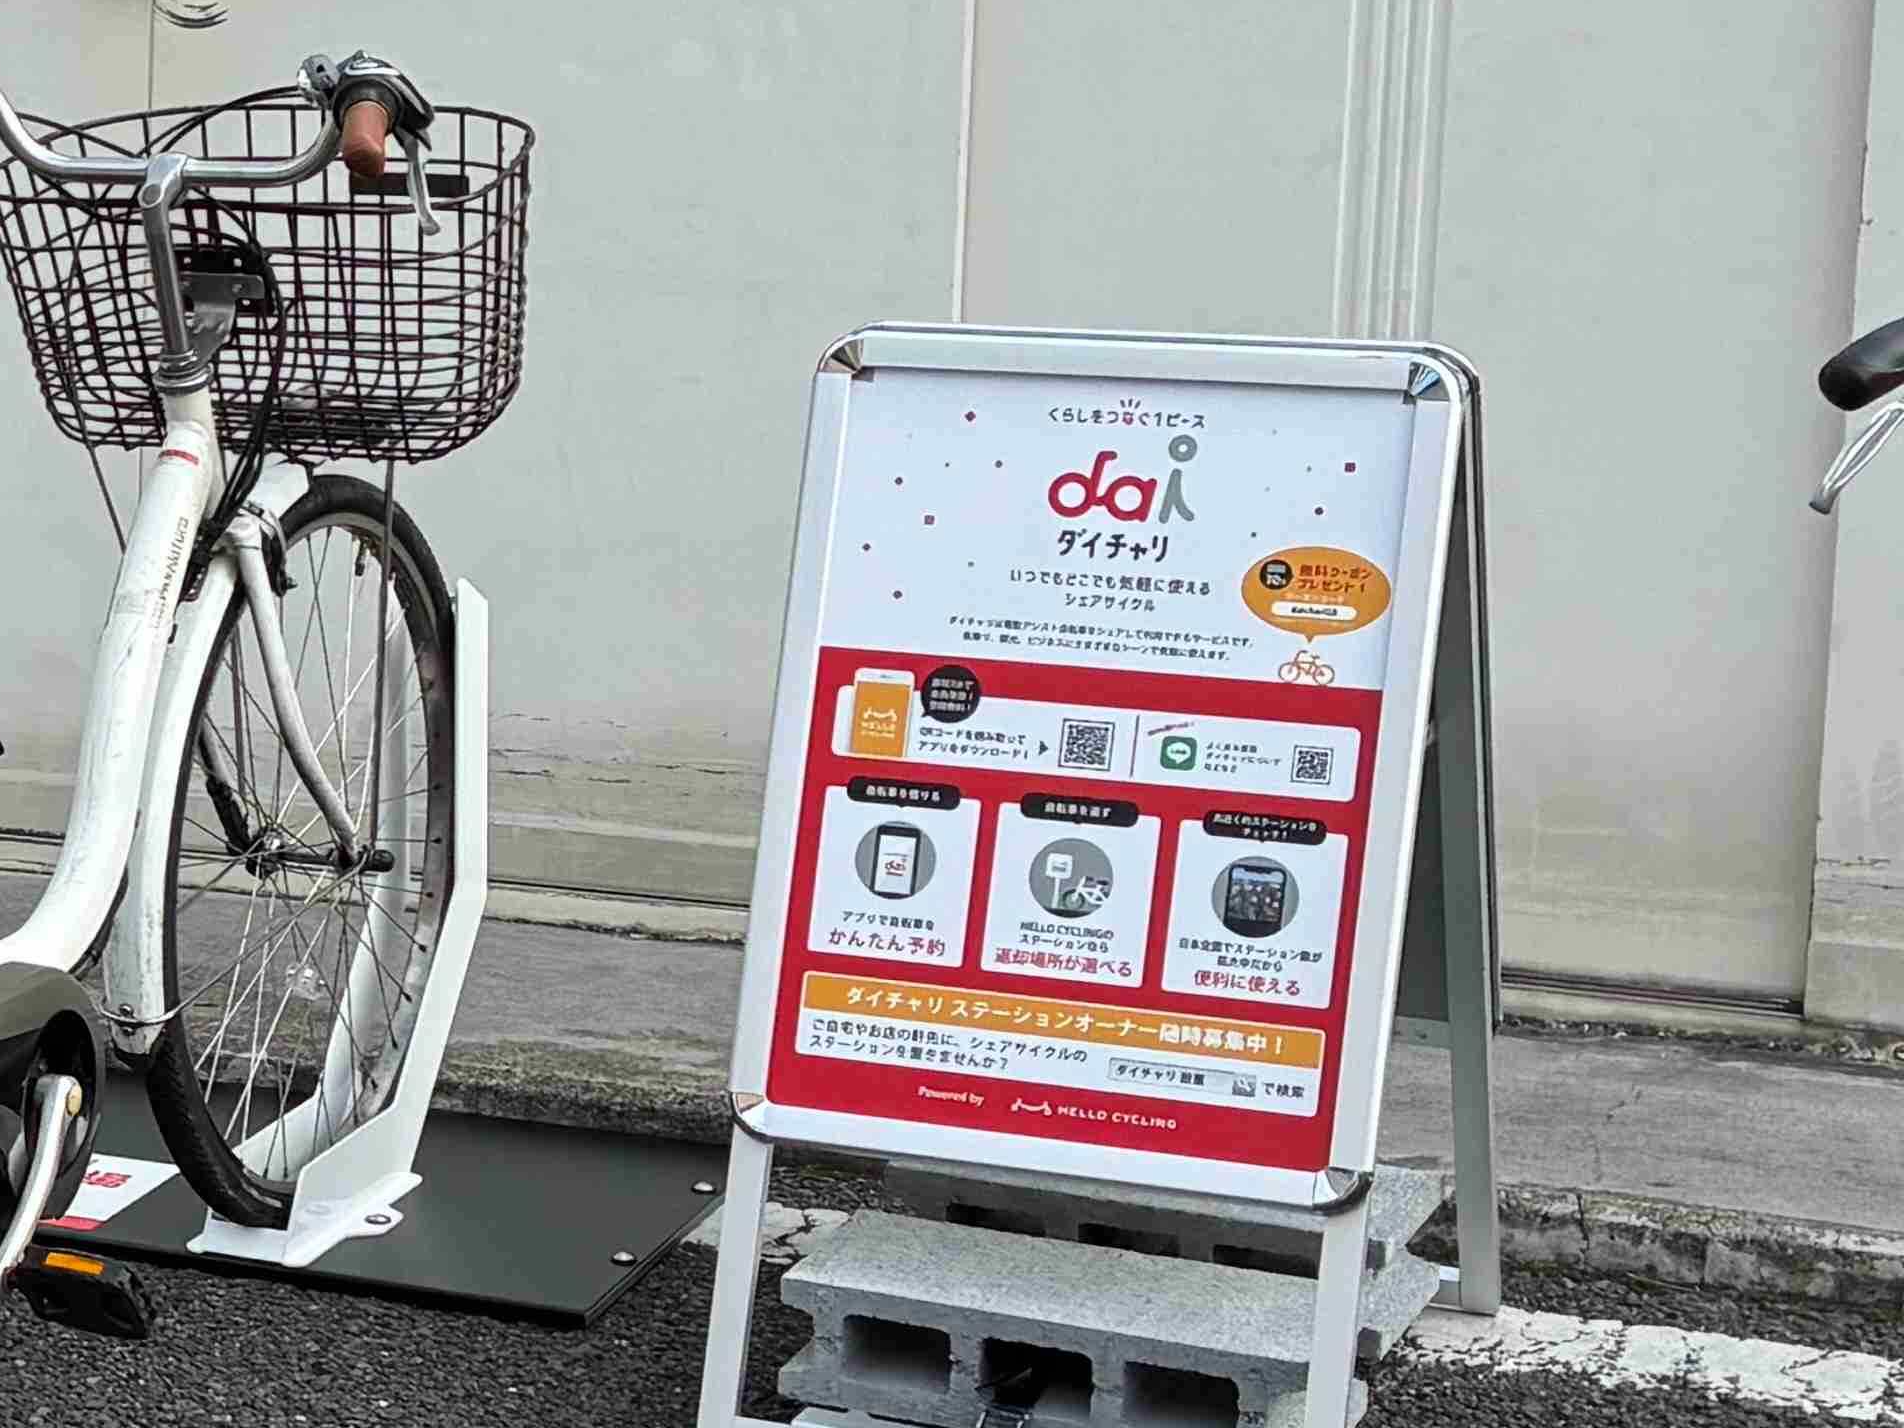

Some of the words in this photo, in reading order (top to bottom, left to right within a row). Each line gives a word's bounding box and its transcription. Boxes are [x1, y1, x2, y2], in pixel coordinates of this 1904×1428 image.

[1048, 434, 1198, 524] dai
[1057, 529, 1169, 563] ダイチャリ
[1009, 567, 1211, 597] いつでもどこでも気軽に使える
[1064, 593, 1156, 613] シェアサイクル
[828, 927, 946, 957] かんたん予約
[1194, 969, 1300, 997] 便利に使える
[847, 986, 943, 1015] ダイチャリ
[1057, 1105, 1107, 1121] HELLO
